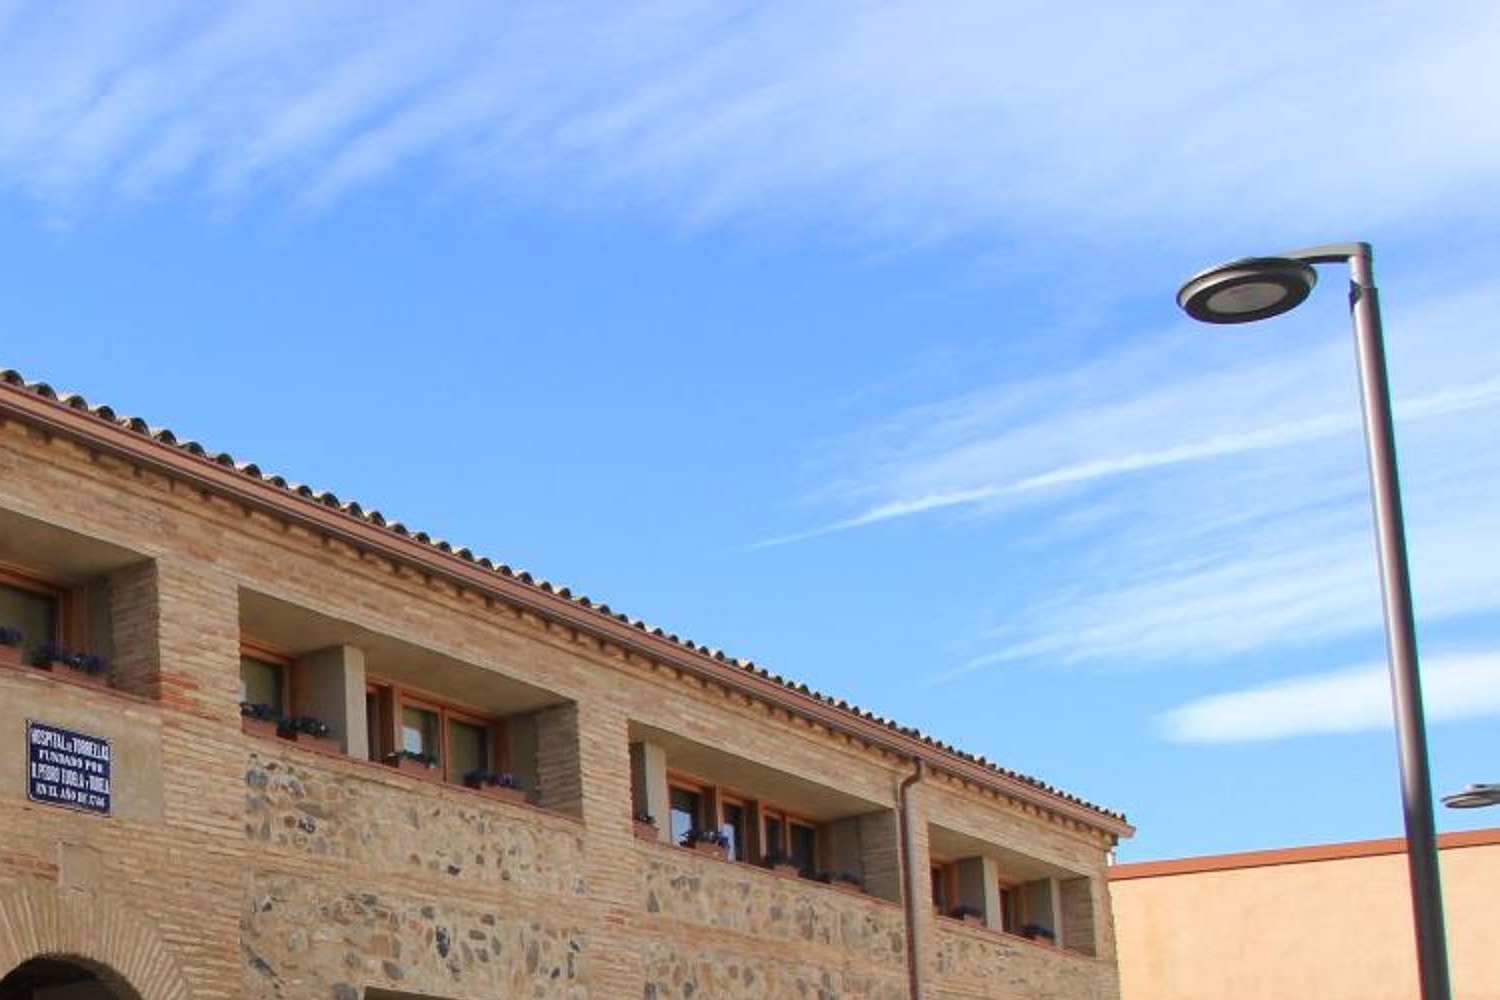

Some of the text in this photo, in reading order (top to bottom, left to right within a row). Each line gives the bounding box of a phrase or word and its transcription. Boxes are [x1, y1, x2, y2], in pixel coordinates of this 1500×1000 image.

[31, 729, 66, 750] HOSPITAL
[39, 749, 103, 773] FUNDADO POR
[36, 783, 47, 796] EN
[48, 785, 58, 797] EL
[59, 786, 76, 801] AÑO
[77, 791, 87, 805] DE
